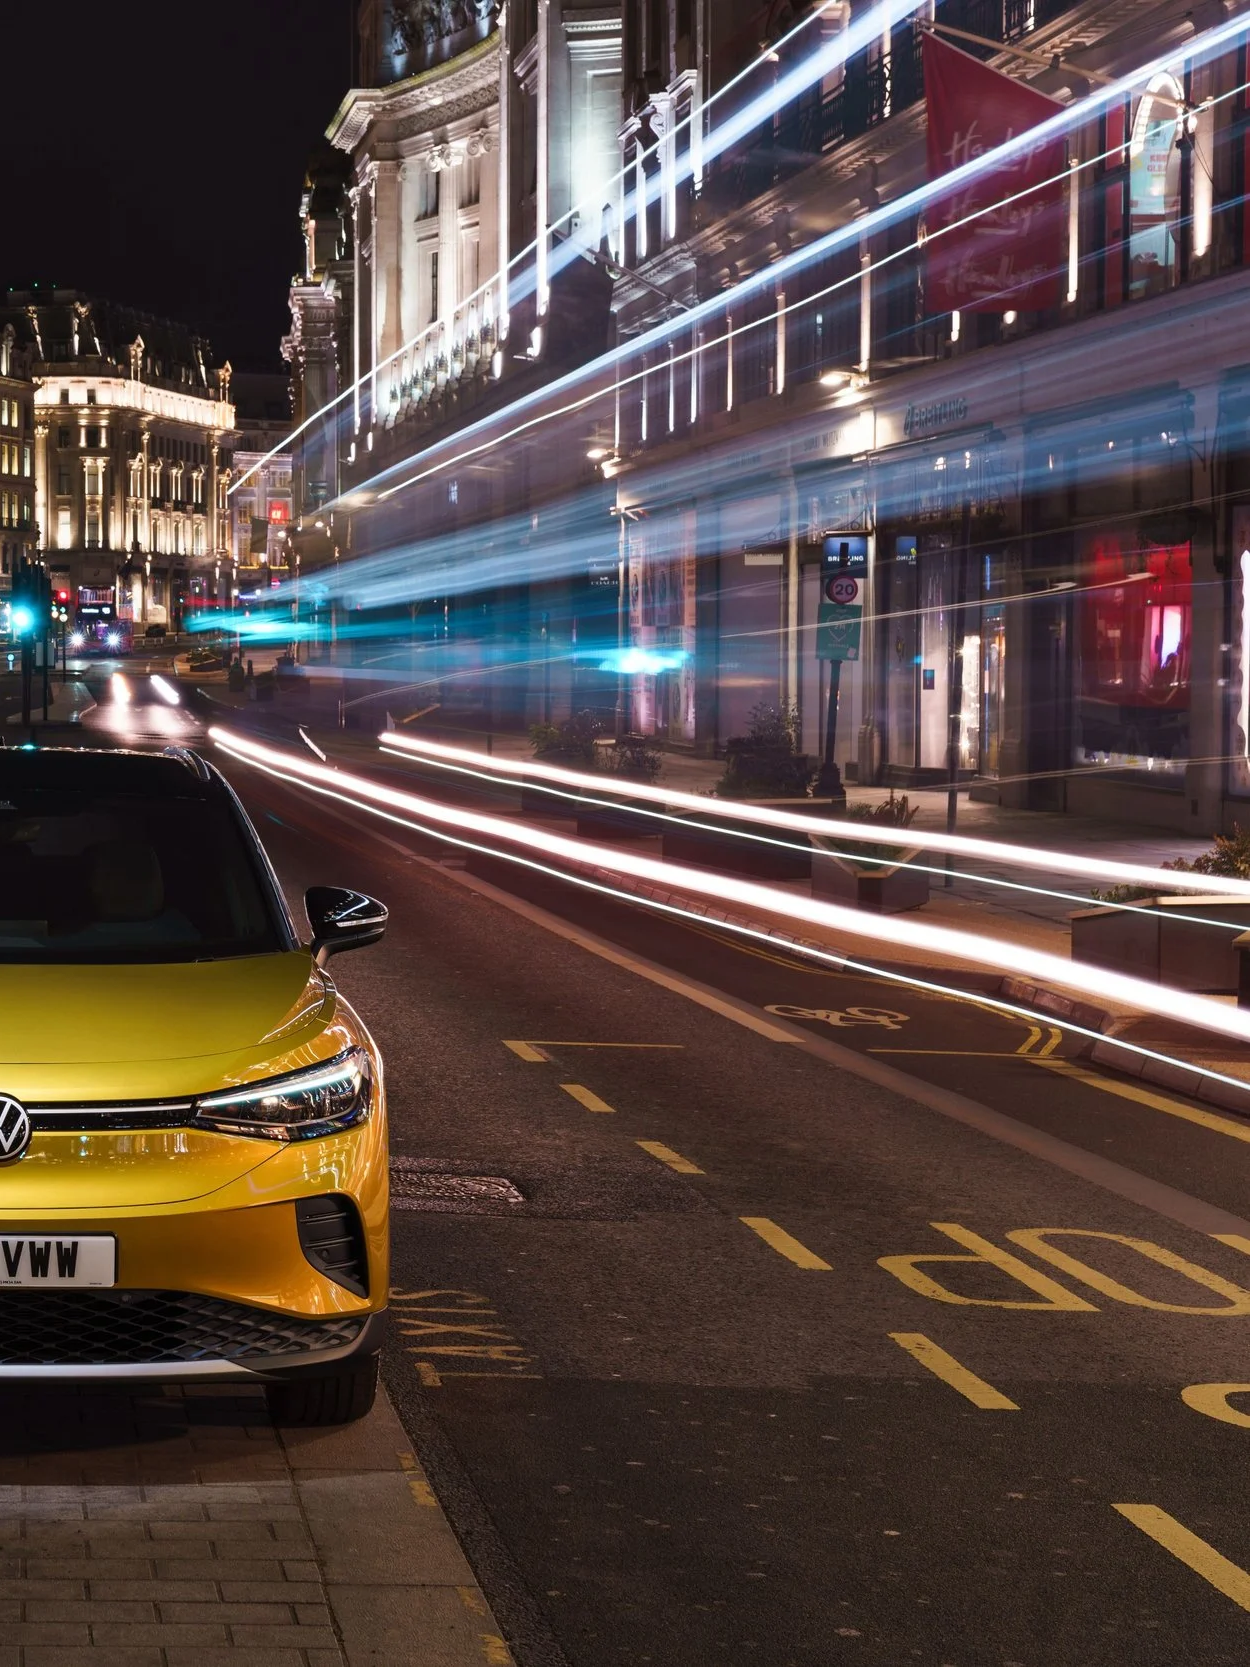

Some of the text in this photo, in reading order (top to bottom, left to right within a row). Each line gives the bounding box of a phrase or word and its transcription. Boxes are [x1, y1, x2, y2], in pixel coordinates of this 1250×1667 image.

[914, 398, 968, 429] BREITLING
[835, 584, 855, 595] 20
[1, 1241, 79, 1278] VWW
[388, 1287, 543, 1387] TAXIS
